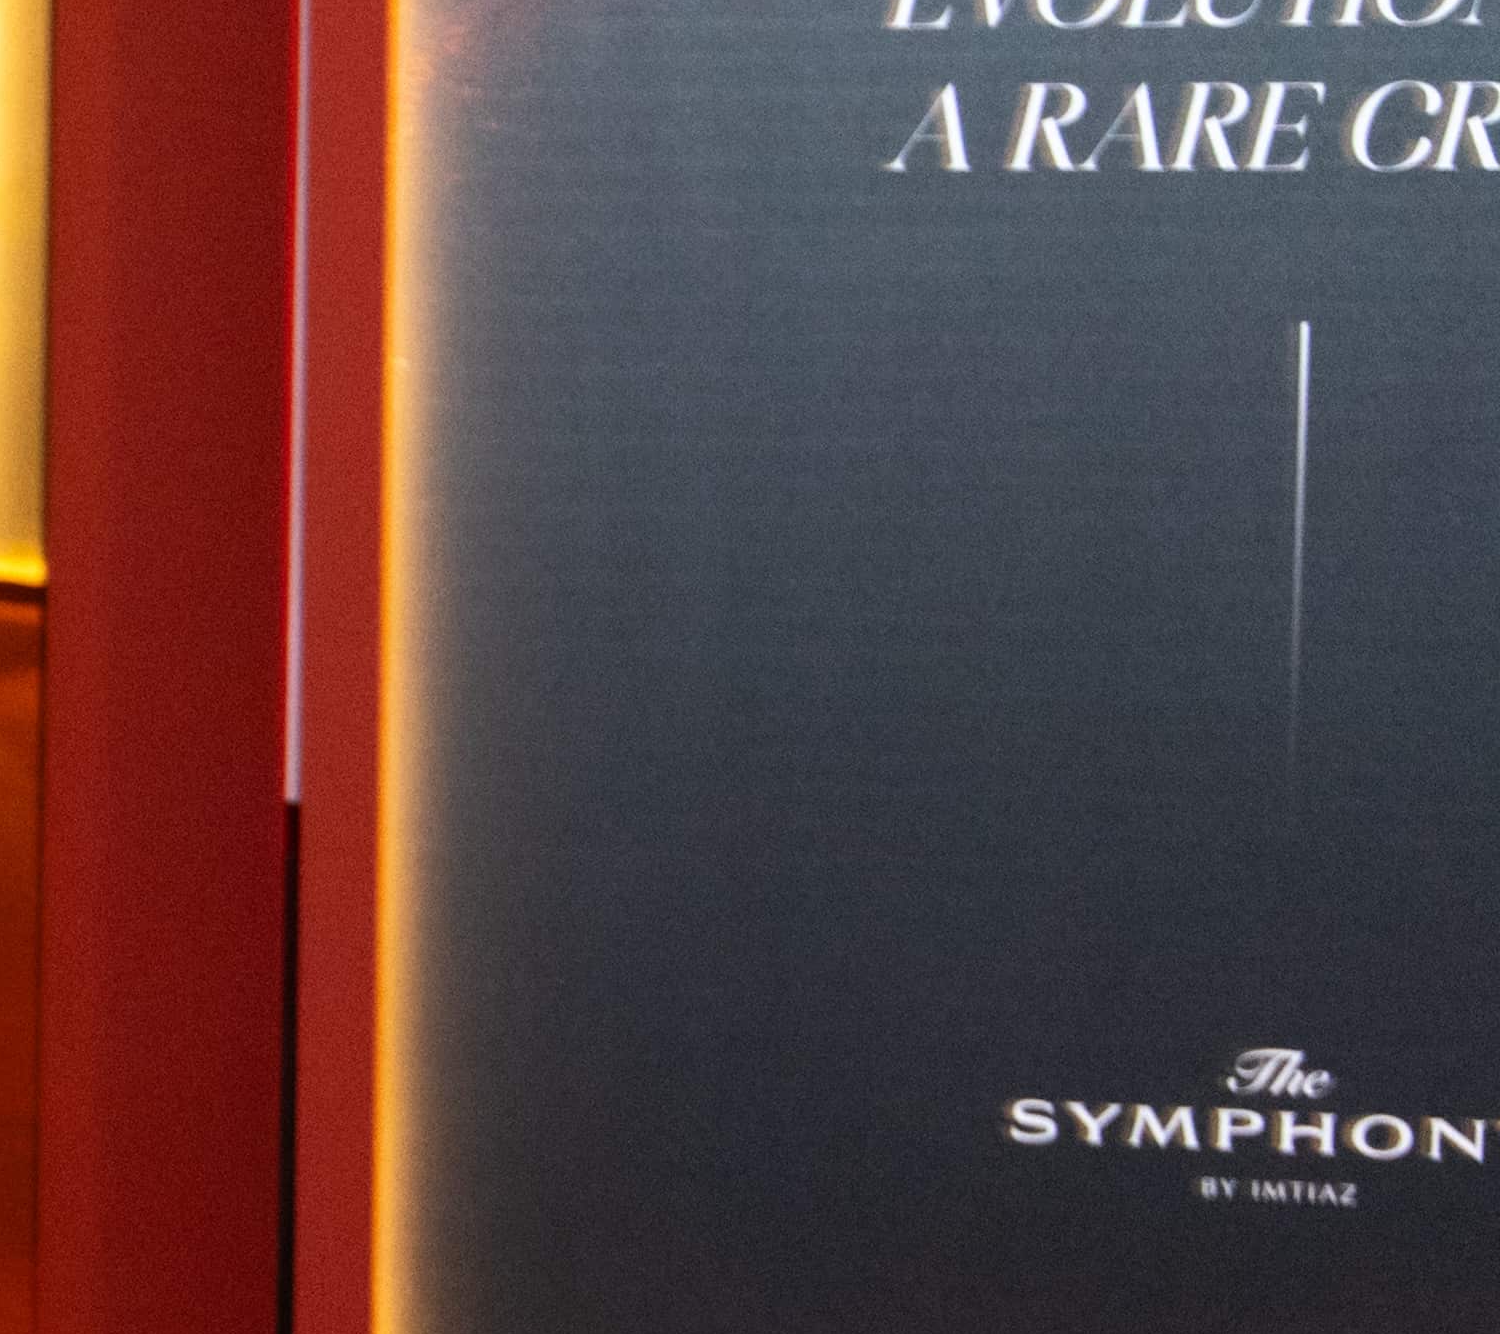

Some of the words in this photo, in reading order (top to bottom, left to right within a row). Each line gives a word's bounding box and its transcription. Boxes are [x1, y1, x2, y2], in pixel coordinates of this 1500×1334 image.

[882, 82, 972, 172] A
[1002, 81, 1325, 173] RARE
[1226, 1046, 1333, 1100] The
[1006, 1097, 1500, 1165] SYMPHON
[1197, 1175, 1237, 1202] BY
[1249, 1178, 1358, 1208] IMTIAZ
